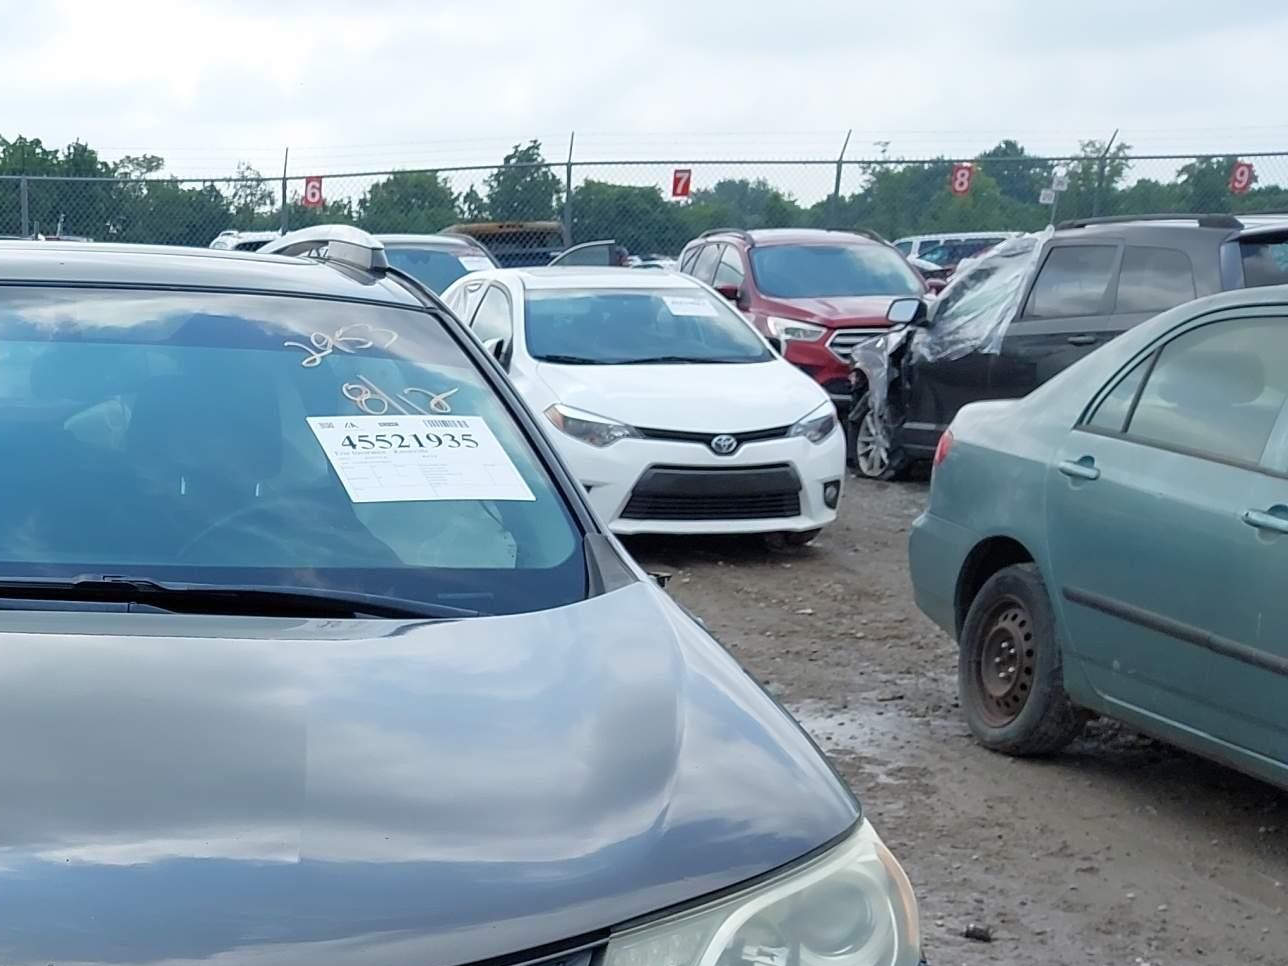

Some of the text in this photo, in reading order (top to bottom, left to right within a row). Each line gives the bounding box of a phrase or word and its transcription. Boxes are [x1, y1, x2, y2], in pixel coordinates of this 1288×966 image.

[675, 172, 689, 194] 7
[955, 169, 969, 191] 8
[1234, 166, 1249, 188] 9
[307, 181, 321, 203] 6
[341, 432, 479, 451] 45521935
